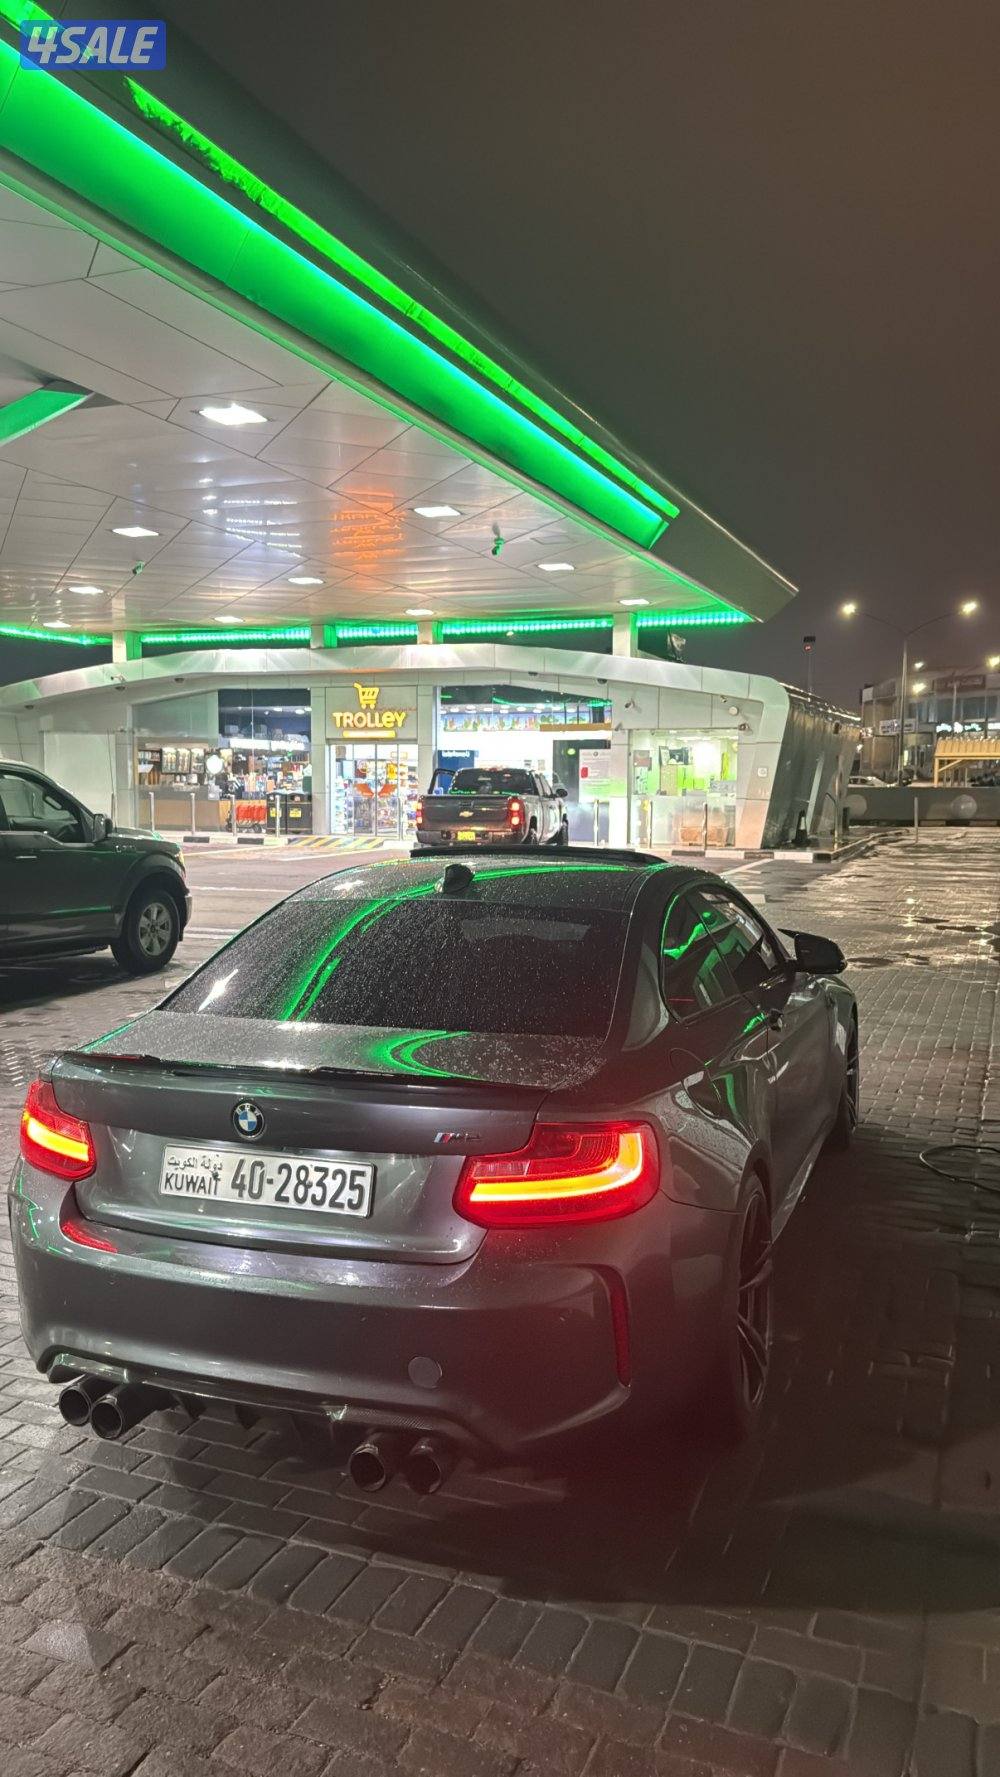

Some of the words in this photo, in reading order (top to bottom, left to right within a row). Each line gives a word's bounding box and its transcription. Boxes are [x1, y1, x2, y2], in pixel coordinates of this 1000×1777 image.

[167, 1156, 198, 1170] الكويت
[200, 1155, 223, 1171] دولة
[164, 1172, 221, 1196] KUWAIT
[231, 1158, 366, 1210] 40-28325
